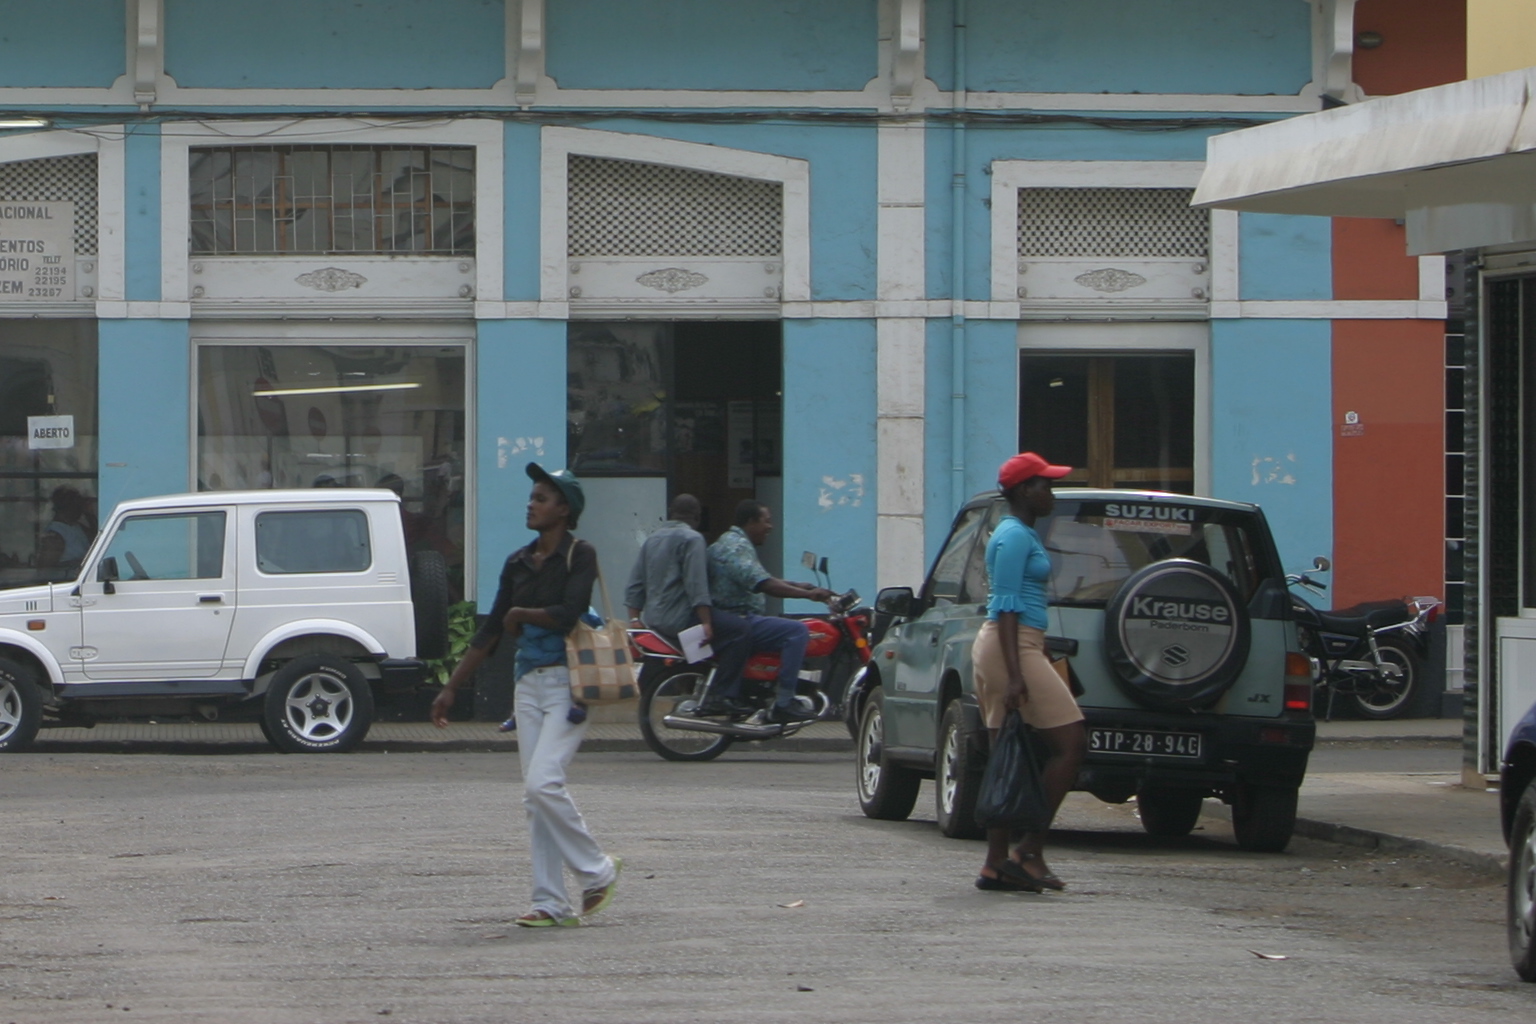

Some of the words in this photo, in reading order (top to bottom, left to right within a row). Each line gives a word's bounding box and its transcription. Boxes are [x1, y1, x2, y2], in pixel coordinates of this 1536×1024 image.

[35, 267, 67, 276] 22194
[34, 276, 67, 286] 22195
[33, 427, 70, 439] ABERTO
[1105, 503, 1195, 521] SUZUKI
[1133, 596, 1229, 622] Krause
[1150, 619, 1210, 633] Paderborn
